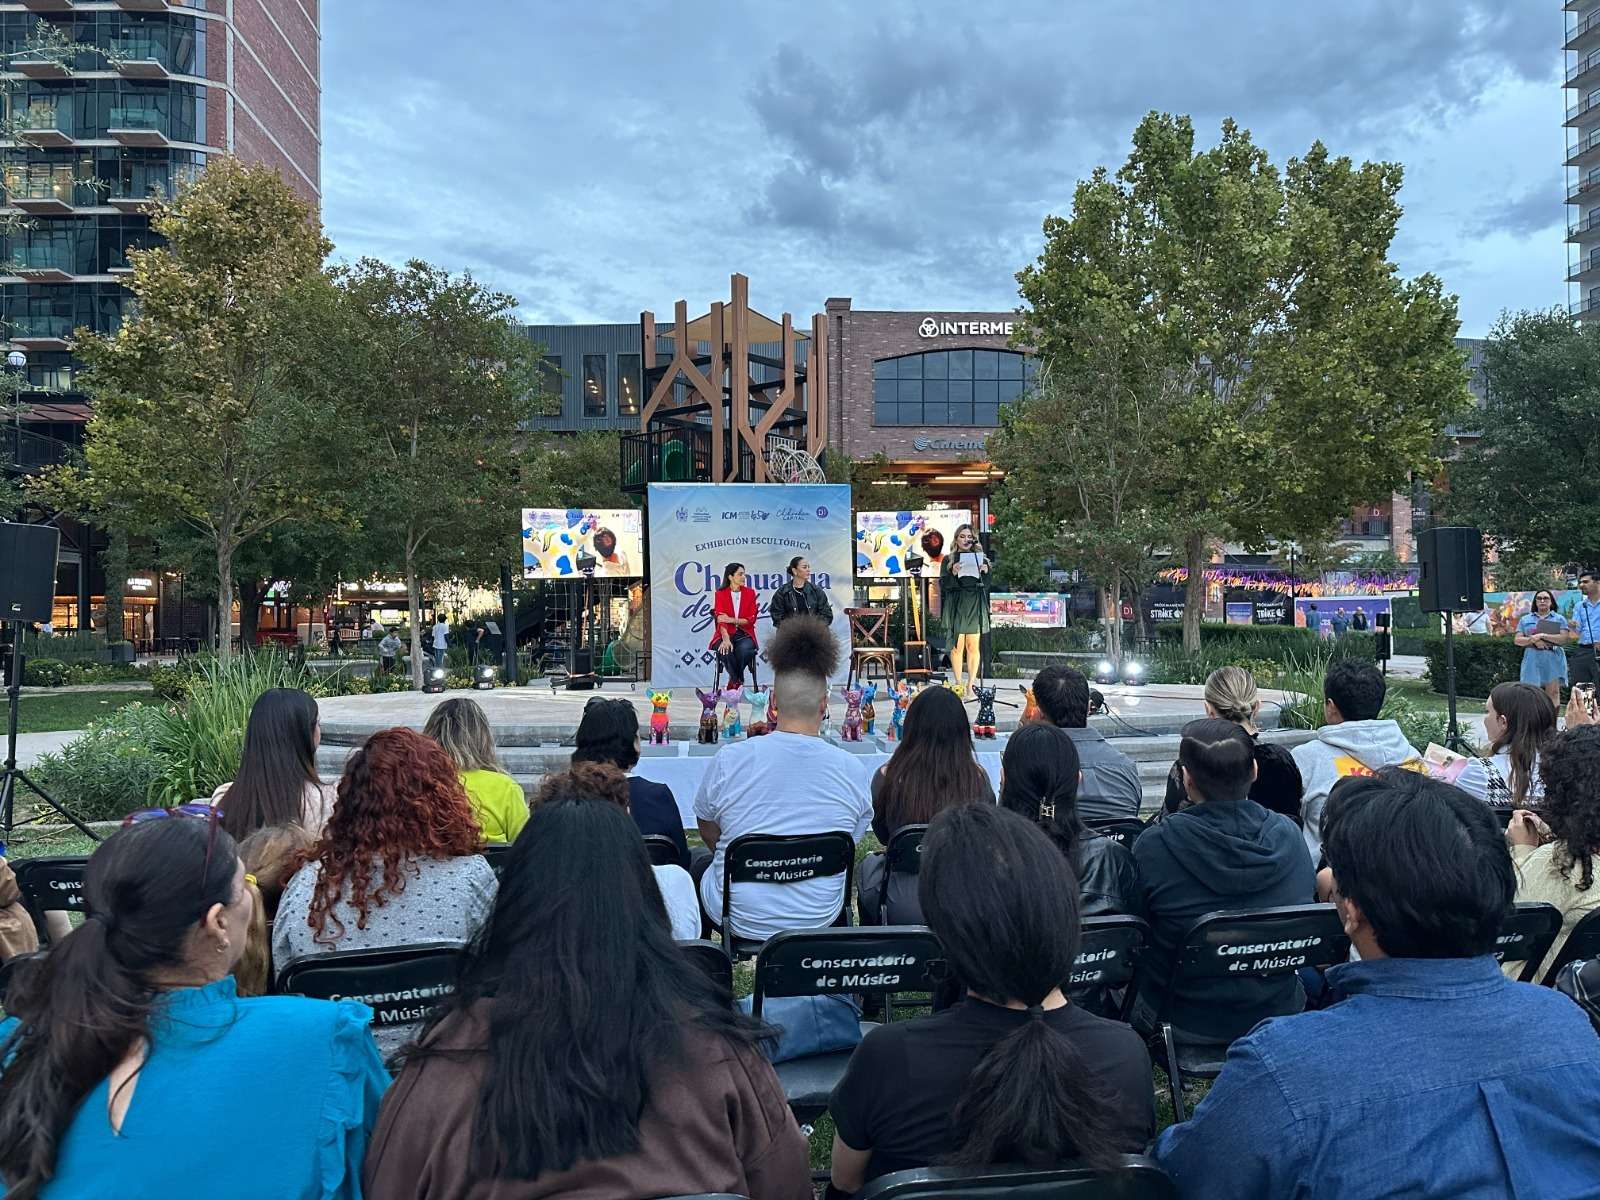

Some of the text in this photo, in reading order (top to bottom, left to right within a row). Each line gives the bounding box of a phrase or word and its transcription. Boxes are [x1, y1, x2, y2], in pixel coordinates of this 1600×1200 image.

[721, 511, 737, 520] ICM
[695, 536, 811, 552] EXHIBICIÓN ESCULTÓRICA
[745, 854, 823, 868] Conservatorio
[756, 869, 815, 881] de Música
[49, 880, 85, 890] Cons
[1217, 936, 1321, 956] Conservatorio
[801, 954, 916, 969] Conservatorio
[1228, 955, 1306, 971] de Música
[816, 973, 900, 987] de Música
